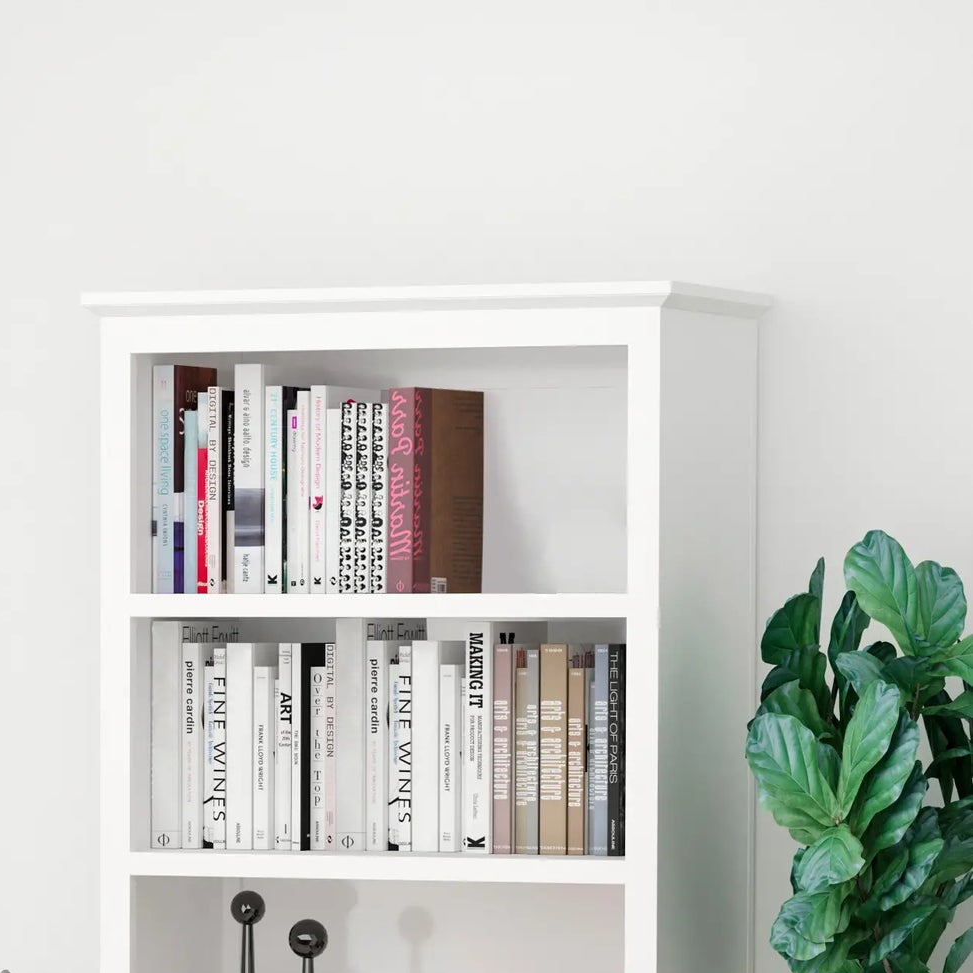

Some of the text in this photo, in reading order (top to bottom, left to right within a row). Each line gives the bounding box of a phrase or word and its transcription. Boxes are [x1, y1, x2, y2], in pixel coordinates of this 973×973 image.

[157, 410, 173, 496] one space living
[208, 387, 217, 501] DIGITAL BY DESIGN
[196, 500, 205, 536] Design
[184, 660, 194, 695] pierre
[369, 658, 378, 694] pierre
[469, 632, 484, 709] MAKING IT
[186, 698, 195, 734] cardin
[213, 677, 226, 729] FINE
[280, 692, 292, 724] ART
[326, 645, 335, 758] DIGITAL BY DESIGN
[371, 697, 380, 734] cardin
[399, 676, 411, 729] FINE
[493, 700, 511, 720] arts
[527, 704, 538, 724] arts
[540, 700, 565, 721] arts
[567, 717, 584, 737] arts
[608, 651, 619, 784] THE LIGHT OF PARIS
[257, 724, 265, 745] FRANK
[213, 741, 226, 822] WINES
[398, 741, 411, 823] WINES
[493, 737, 511, 800] architecture
[527, 740, 538, 802] architecture
[540, 737, 565, 801] architecture
[567, 751, 584, 807] architecture
